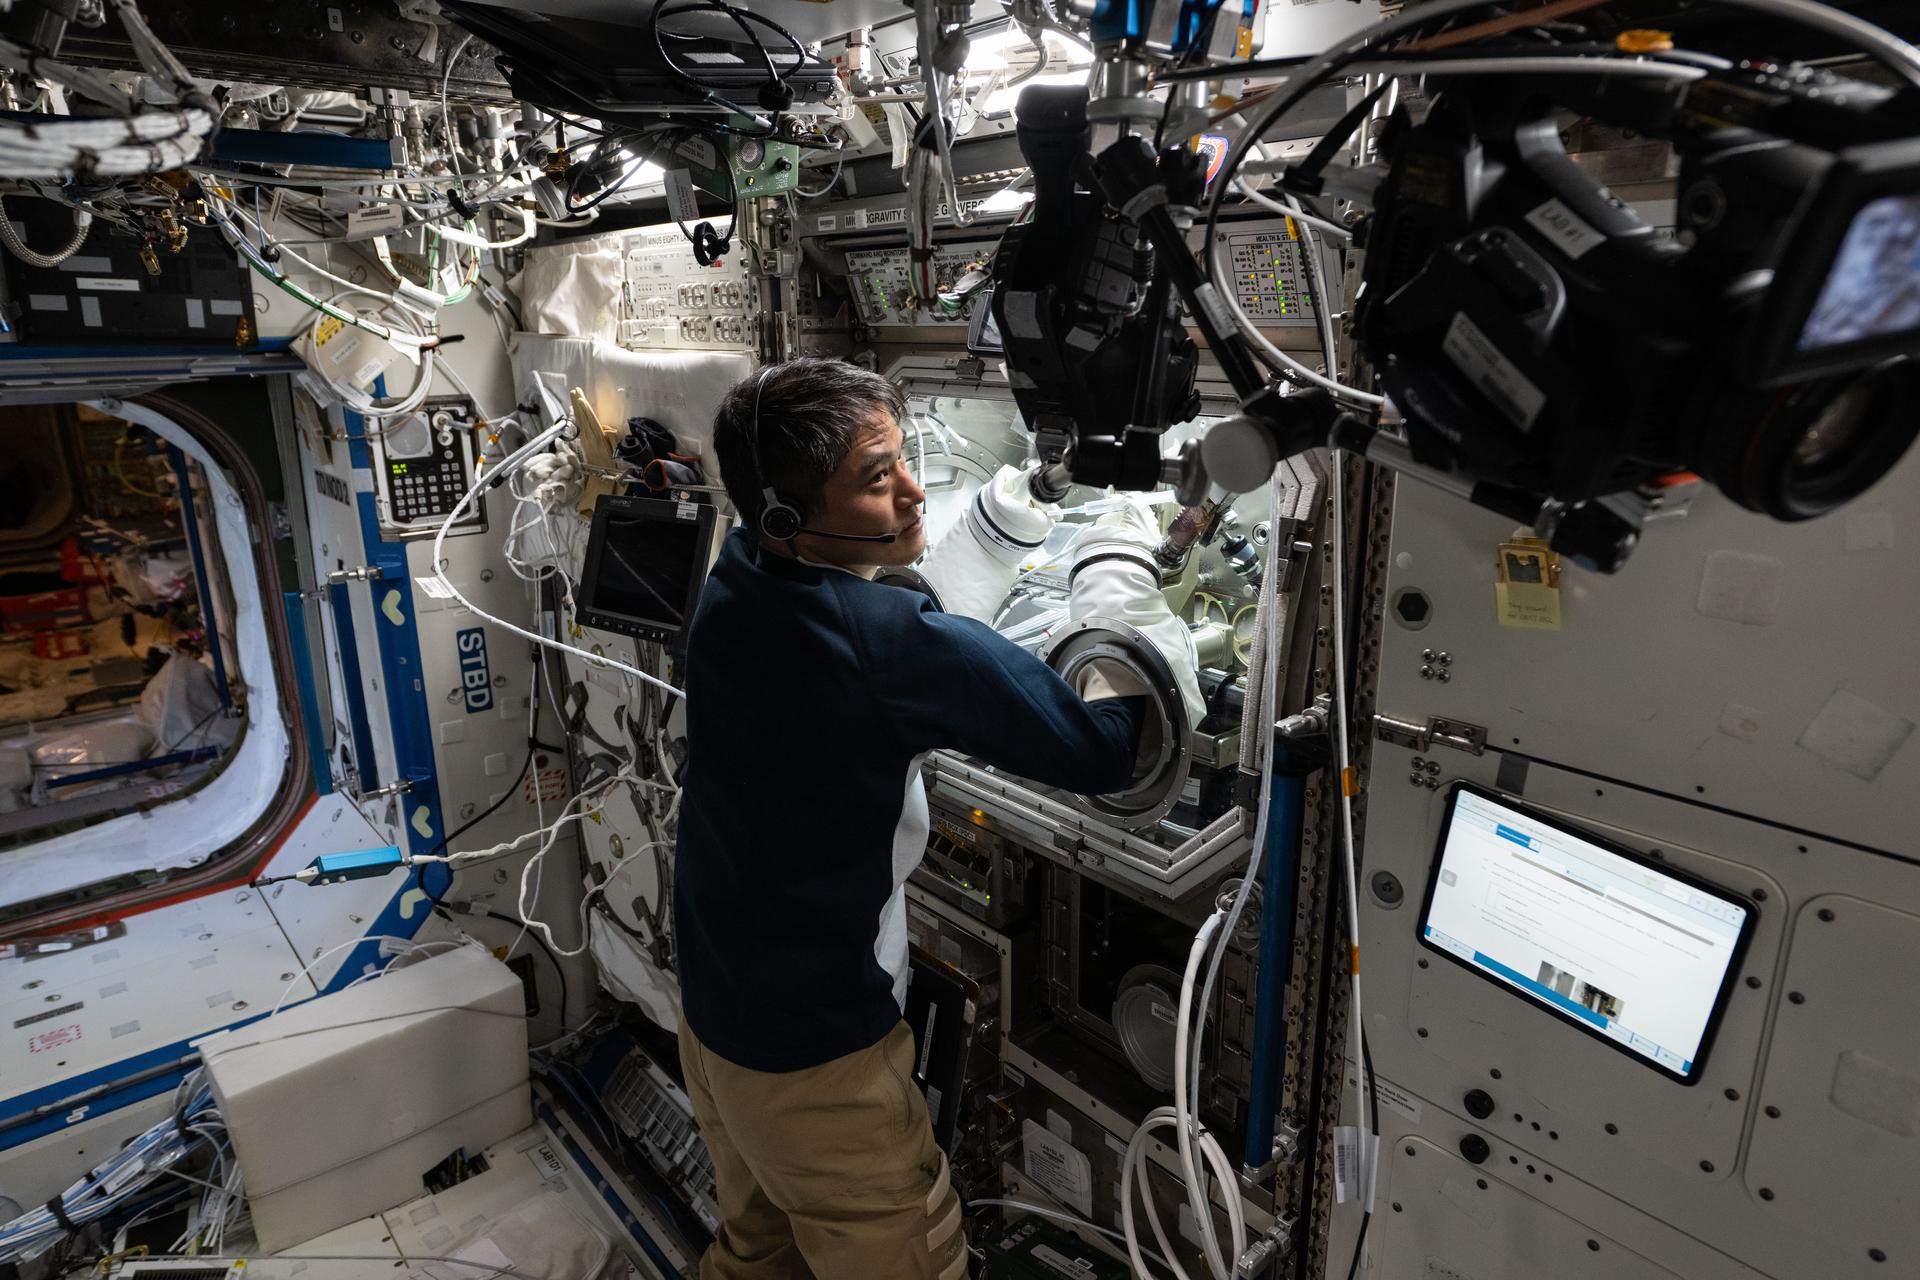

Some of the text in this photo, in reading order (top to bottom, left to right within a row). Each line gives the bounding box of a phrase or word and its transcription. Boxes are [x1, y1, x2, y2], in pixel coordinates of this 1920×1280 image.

[647, 234, 663, 245] MINUS
[663, 232, 681, 243] EIGHTY
[459, 632, 491, 709] STBD
[538, 1146, 562, 1172] LAB1D1
